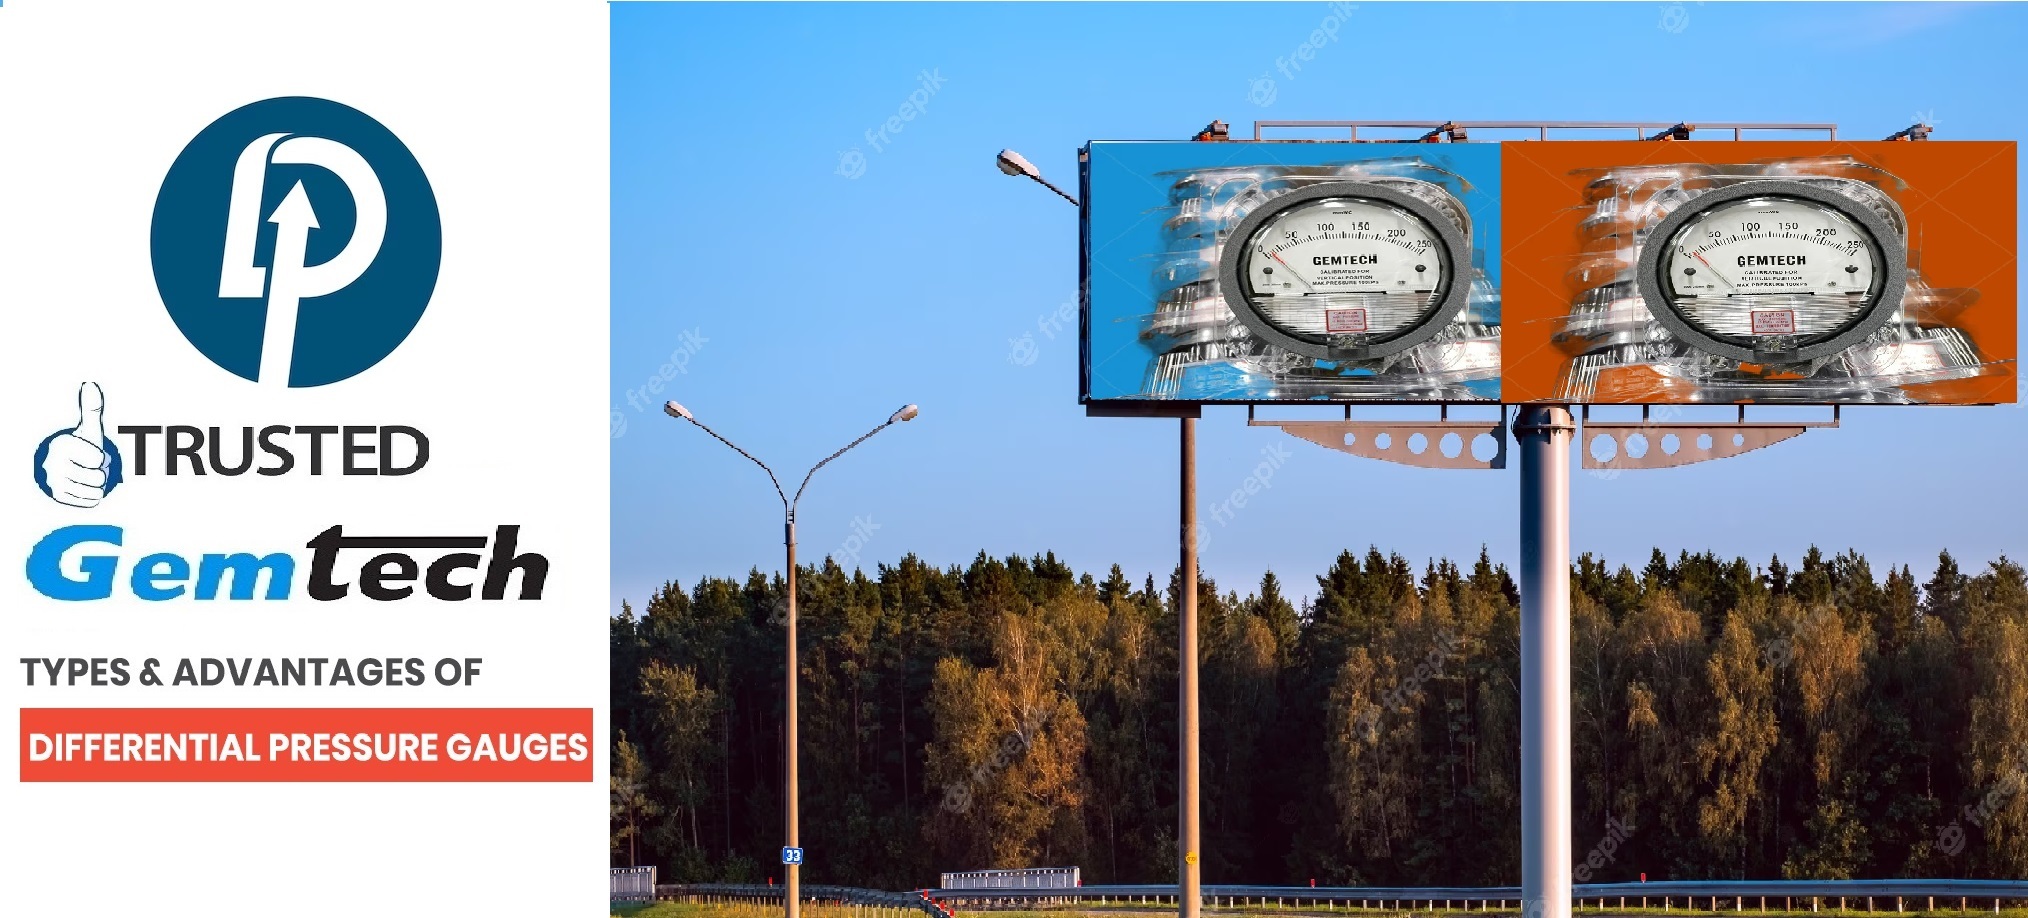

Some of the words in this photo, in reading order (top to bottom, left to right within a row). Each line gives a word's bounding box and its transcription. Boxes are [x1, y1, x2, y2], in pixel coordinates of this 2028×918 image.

[1257, 245, 1263, 253] 0
[1285, 230, 1298, 239] 50
[1316, 222, 1335, 231] 100
[1351, 221, 1370, 231] 150
[1387, 229, 1406, 238] 200
[1416, 240, 1432, 248] 250
[1678, 245, 1684, 253] 0
[1708, 230, 1721, 239] 50
[1741, 222, 1760, 231] 100
[1778, 222, 1799, 230] 150
[1815, 228, 1837, 237] 200
[1847, 240, 1864, 249] 250
[1312, 254, 1378, 266] GEMTECH
[1737, 255, 1806, 267] GEMTECH
[119, 425, 429, 476] TRUSTED
[20, 658, 130, 686] TYPES
[140, 658, 163, 686] &
[172, 658, 425, 686] ADVANTAGES
[435, 658, 482, 686] OF
[30, 733, 260, 761] DIFFERENTIAL
[270, 733, 437, 761] PRESSURE
[447, 733, 588, 761] GAUGES
[786, 849, 801, 862] 33
